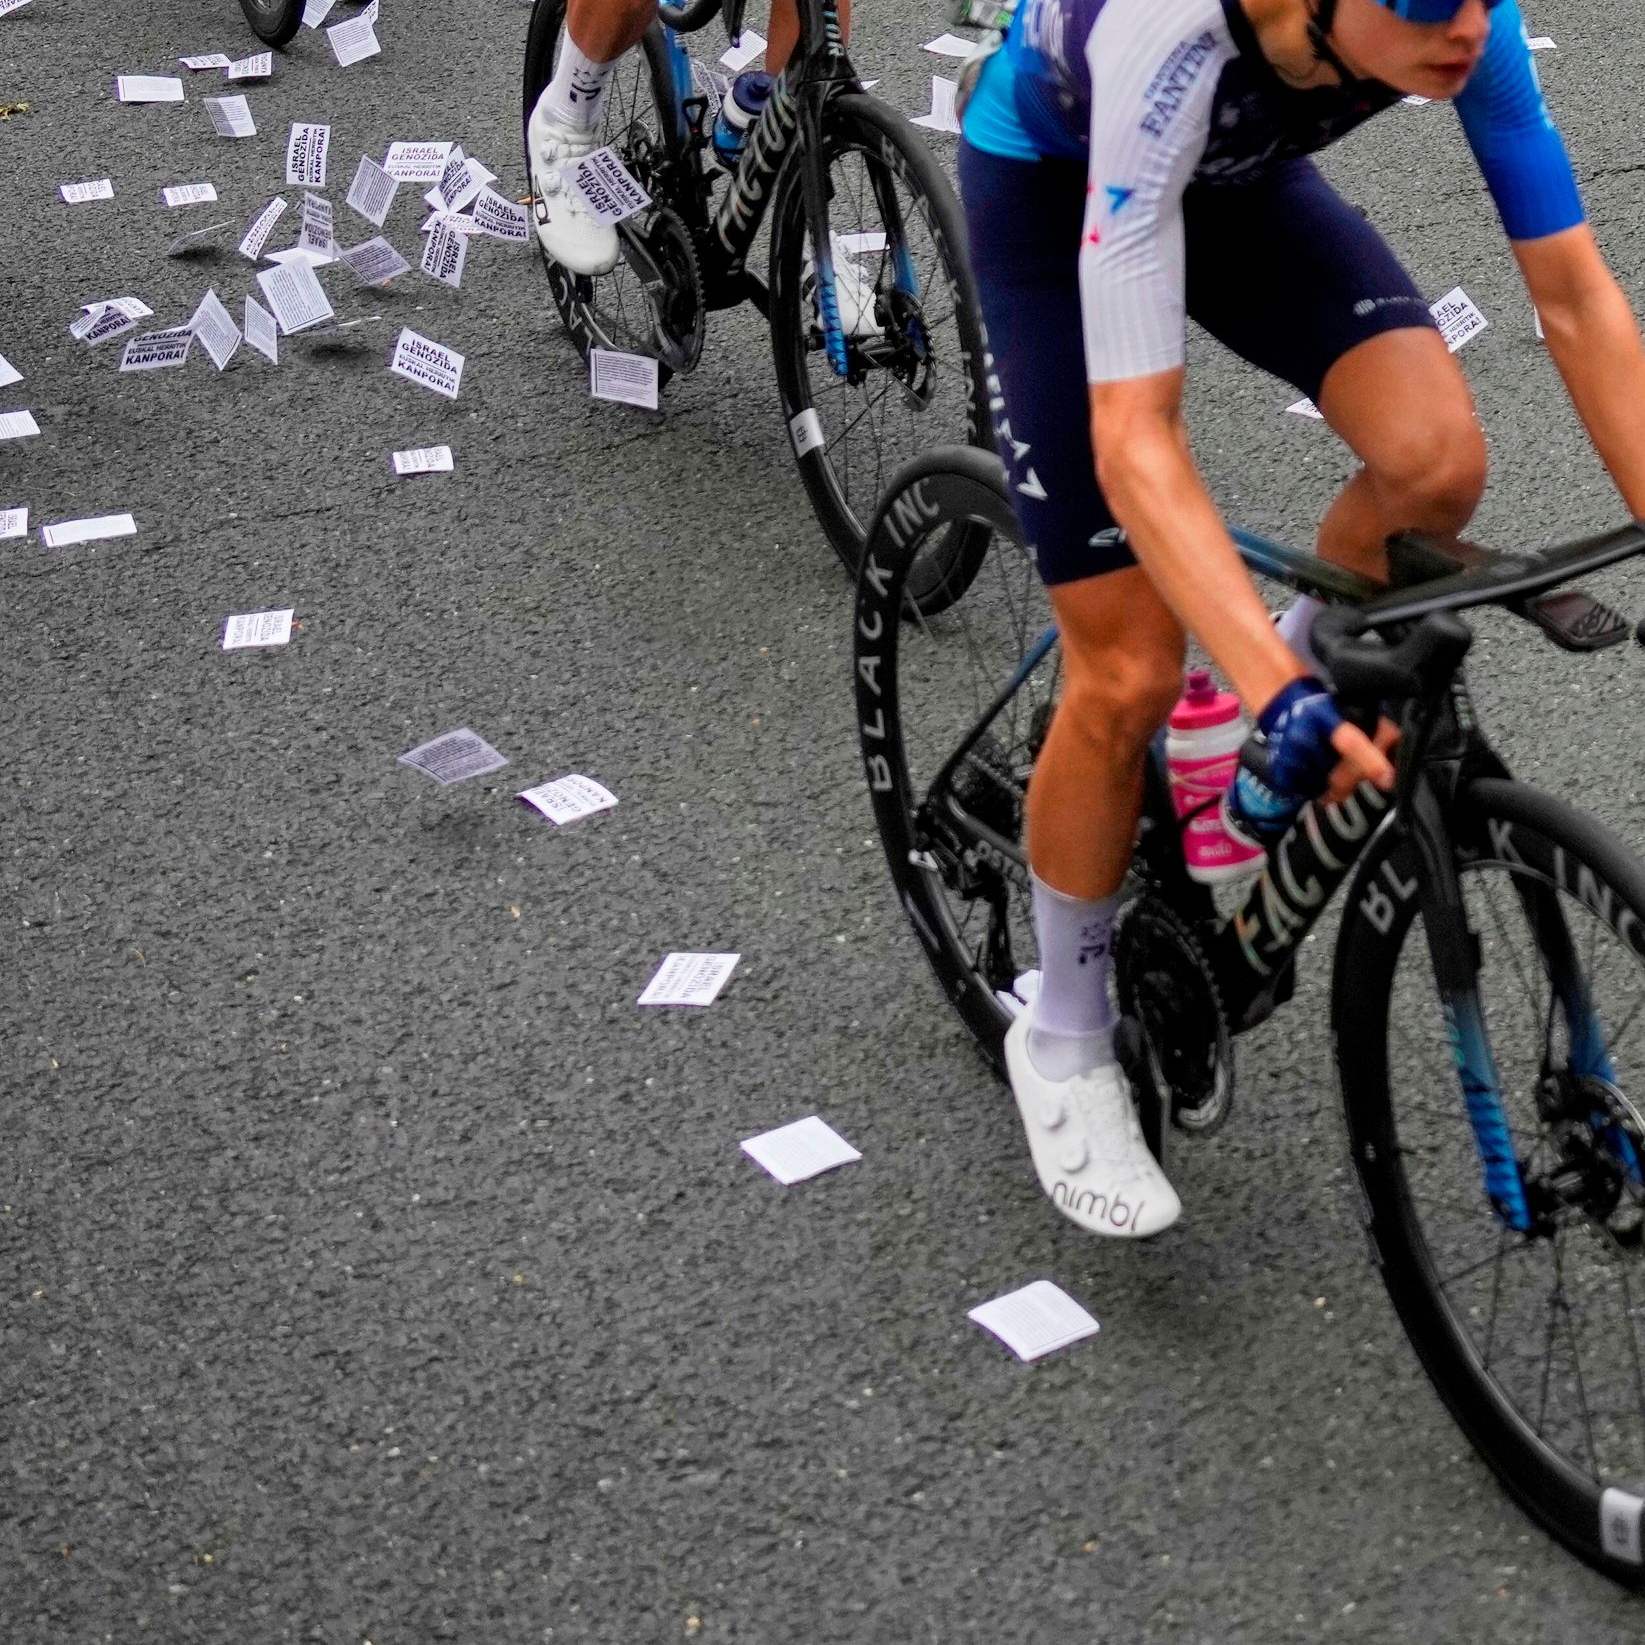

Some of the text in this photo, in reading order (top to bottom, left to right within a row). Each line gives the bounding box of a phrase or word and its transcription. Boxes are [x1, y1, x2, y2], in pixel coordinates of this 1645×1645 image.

[1139, 31, 1218, 137] FANTINI
[291, 134, 302, 173] ISRAEL
[298, 127, 310, 183] GENOZIDA
[314, 128, 326, 184] KANPORA!
[391, 153, 444, 161] GENOZIDA
[402, 146, 439, 154] ISRAEL
[576, 174, 607, 214] ISRAEL
[577, 162, 622, 216] GENOZIDA
[598, 151, 645, 205] KANPORA!
[478, 199, 526, 223] GENOZIDA
[486, 195, 517, 215] ISRAEL
[424, 221, 442, 272] KANPORA!
[474, 217, 527, 239] KANPORA!
[438, 229, 456, 279] GENOZIDA
[447, 241, 461, 275] ISRAEL
[86, 317, 131, 341] KANPORA!
[125, 349, 185, 365] KANPORA!
[402, 342, 458, 374] GENOZIDA
[411, 339, 451, 363] ISRAEL
[398, 361, 455, 392] KANPORA!
[884, 486, 940, 550] INC
[856, 562, 895, 792] BLACK
[1052, 1181, 1145, 1232] nimbl
